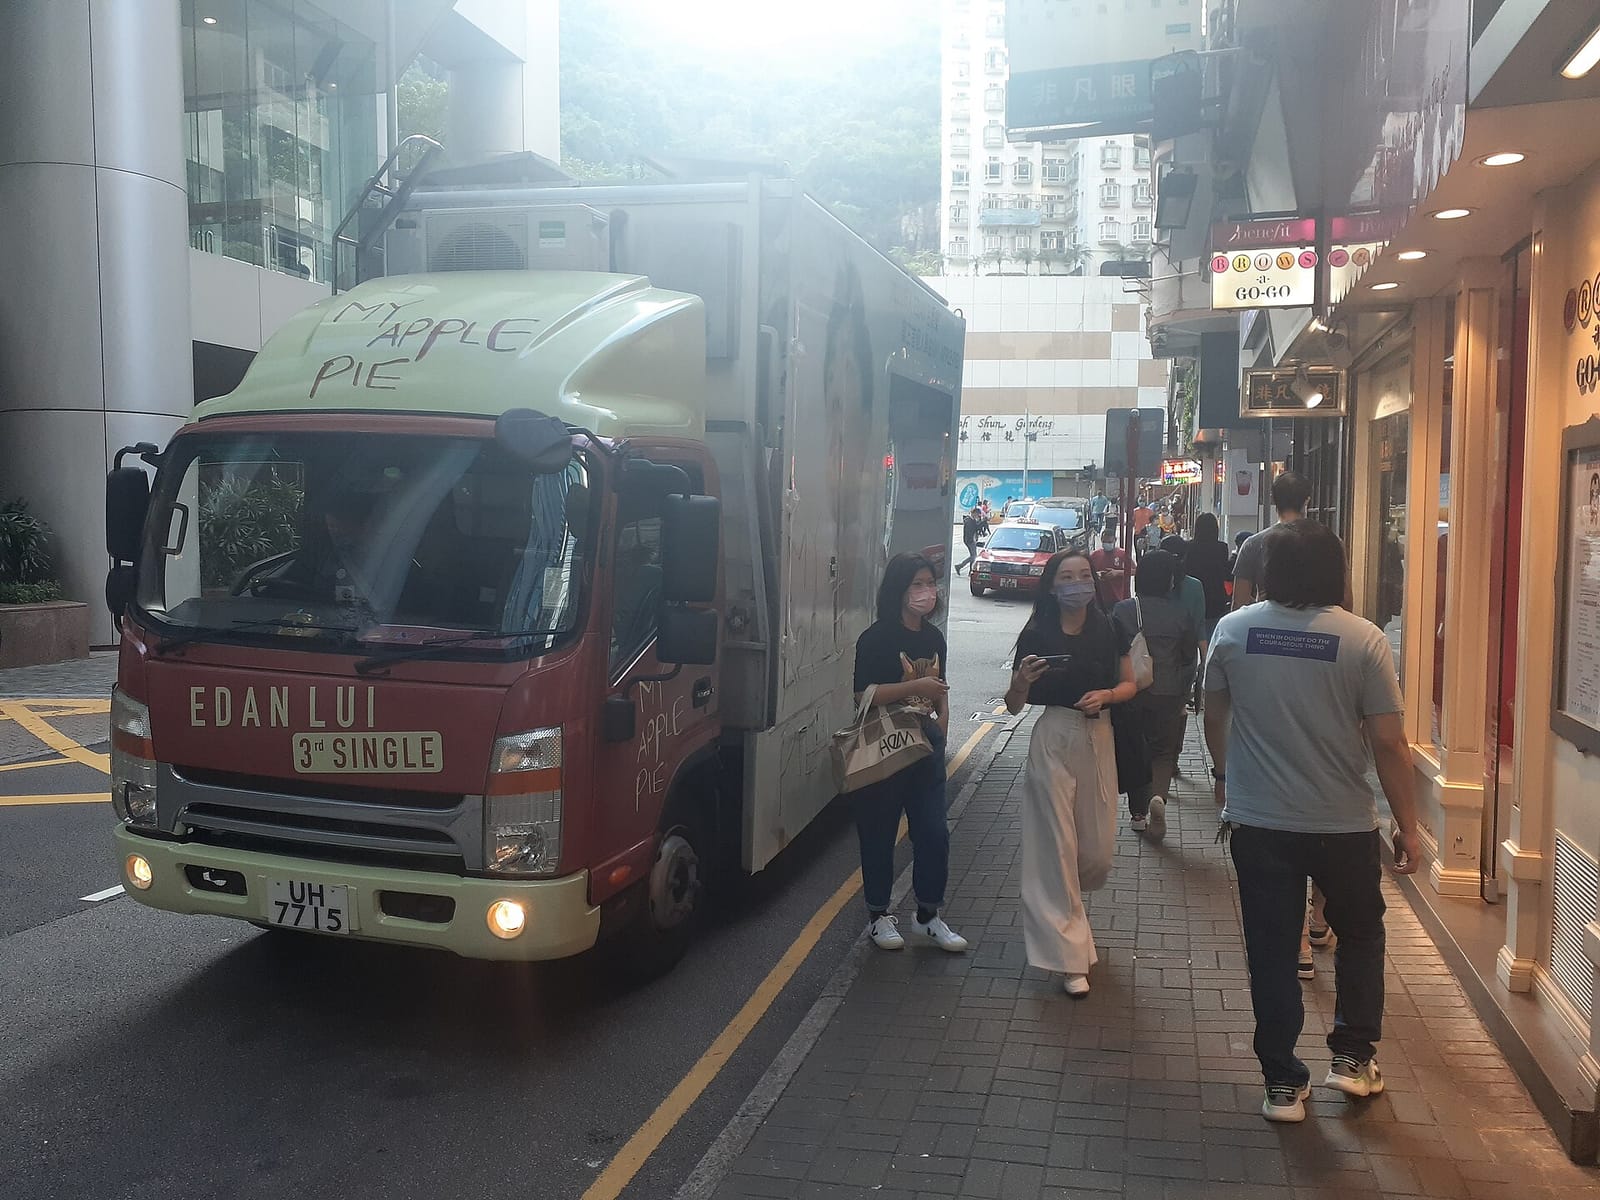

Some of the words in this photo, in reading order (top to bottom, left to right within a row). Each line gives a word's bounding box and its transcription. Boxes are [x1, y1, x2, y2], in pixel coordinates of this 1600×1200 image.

[1213, 251, 1316, 272] BROWS
[1235, 285, 1291, 300] GO-GO
[333, 299, 424, 328] MY
[366, 317, 540, 361] APPLE
[309, 355, 410, 399] PIE
[1256, 383, 1332, 401] 非凡鏡
[978, 416, 1006, 428] Shun
[190, 686, 290, 728] EDAN
[309, 686, 376, 728] LUI
[637, 696, 684, 763] APPLE
[299, 740, 325, 769] 3rd
[332, 736, 436, 770] SINGLE
[635, 761, 665, 813] PIE
[288, 880, 327, 909] UH
[273, 900, 342, 932] 7715
